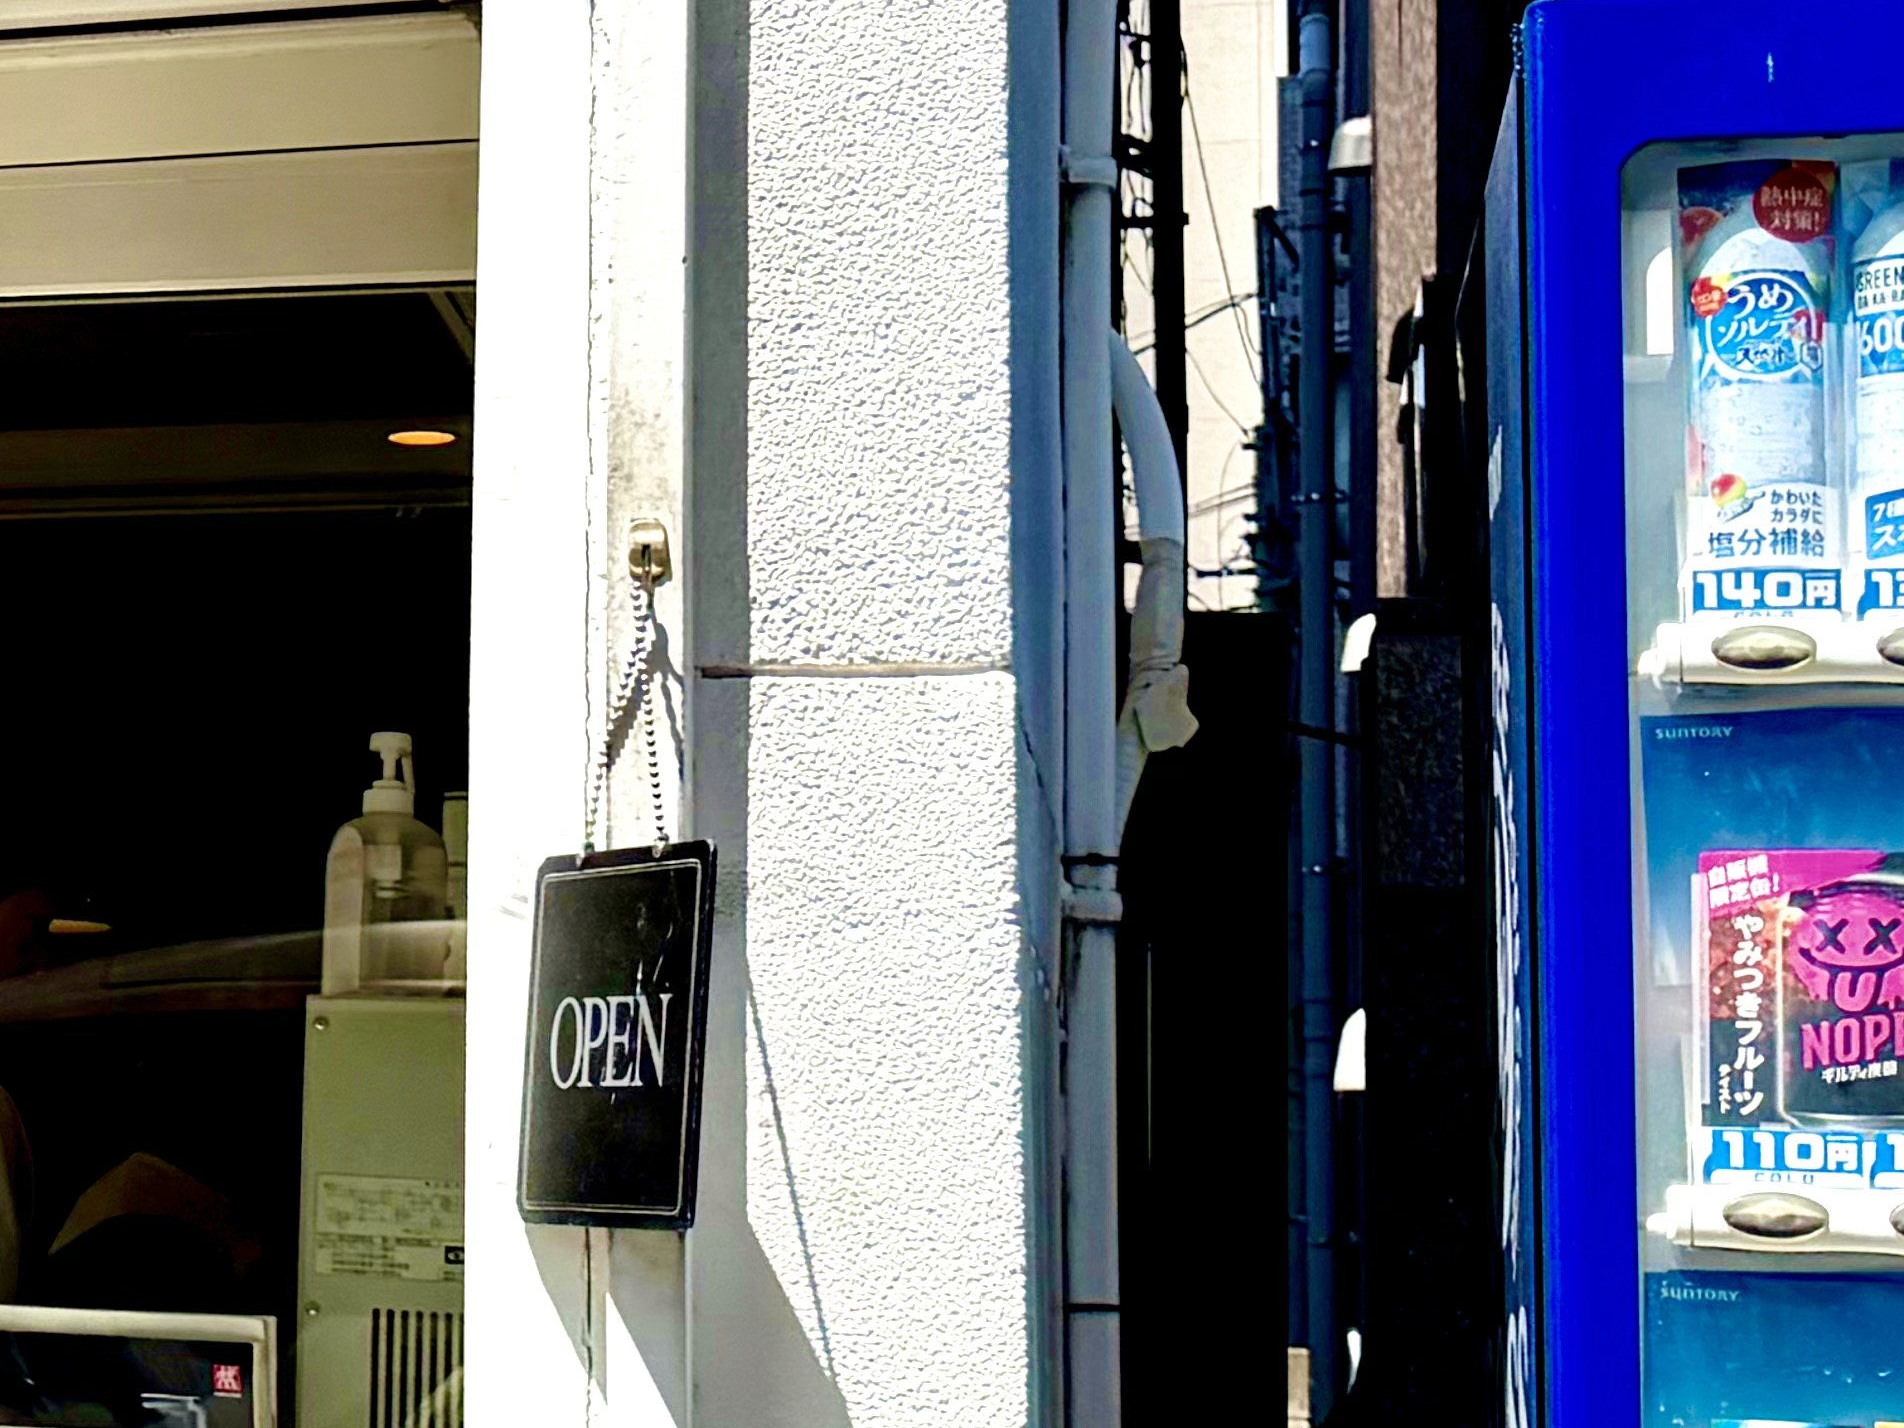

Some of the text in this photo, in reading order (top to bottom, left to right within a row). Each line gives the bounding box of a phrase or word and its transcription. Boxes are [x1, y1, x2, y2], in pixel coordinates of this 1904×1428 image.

[1770, 489, 1823, 507] かわいた
[1771, 508, 1823, 524] カラダに
[1708, 528, 1825, 558] 塩分補給
[1696, 572, 1837, 609] 140円
[1732, 914, 1765, 1116] やみつきフルーツ
[550, 993, 673, 1090] OPEN
[1723, 1130, 1858, 1171] 110円
